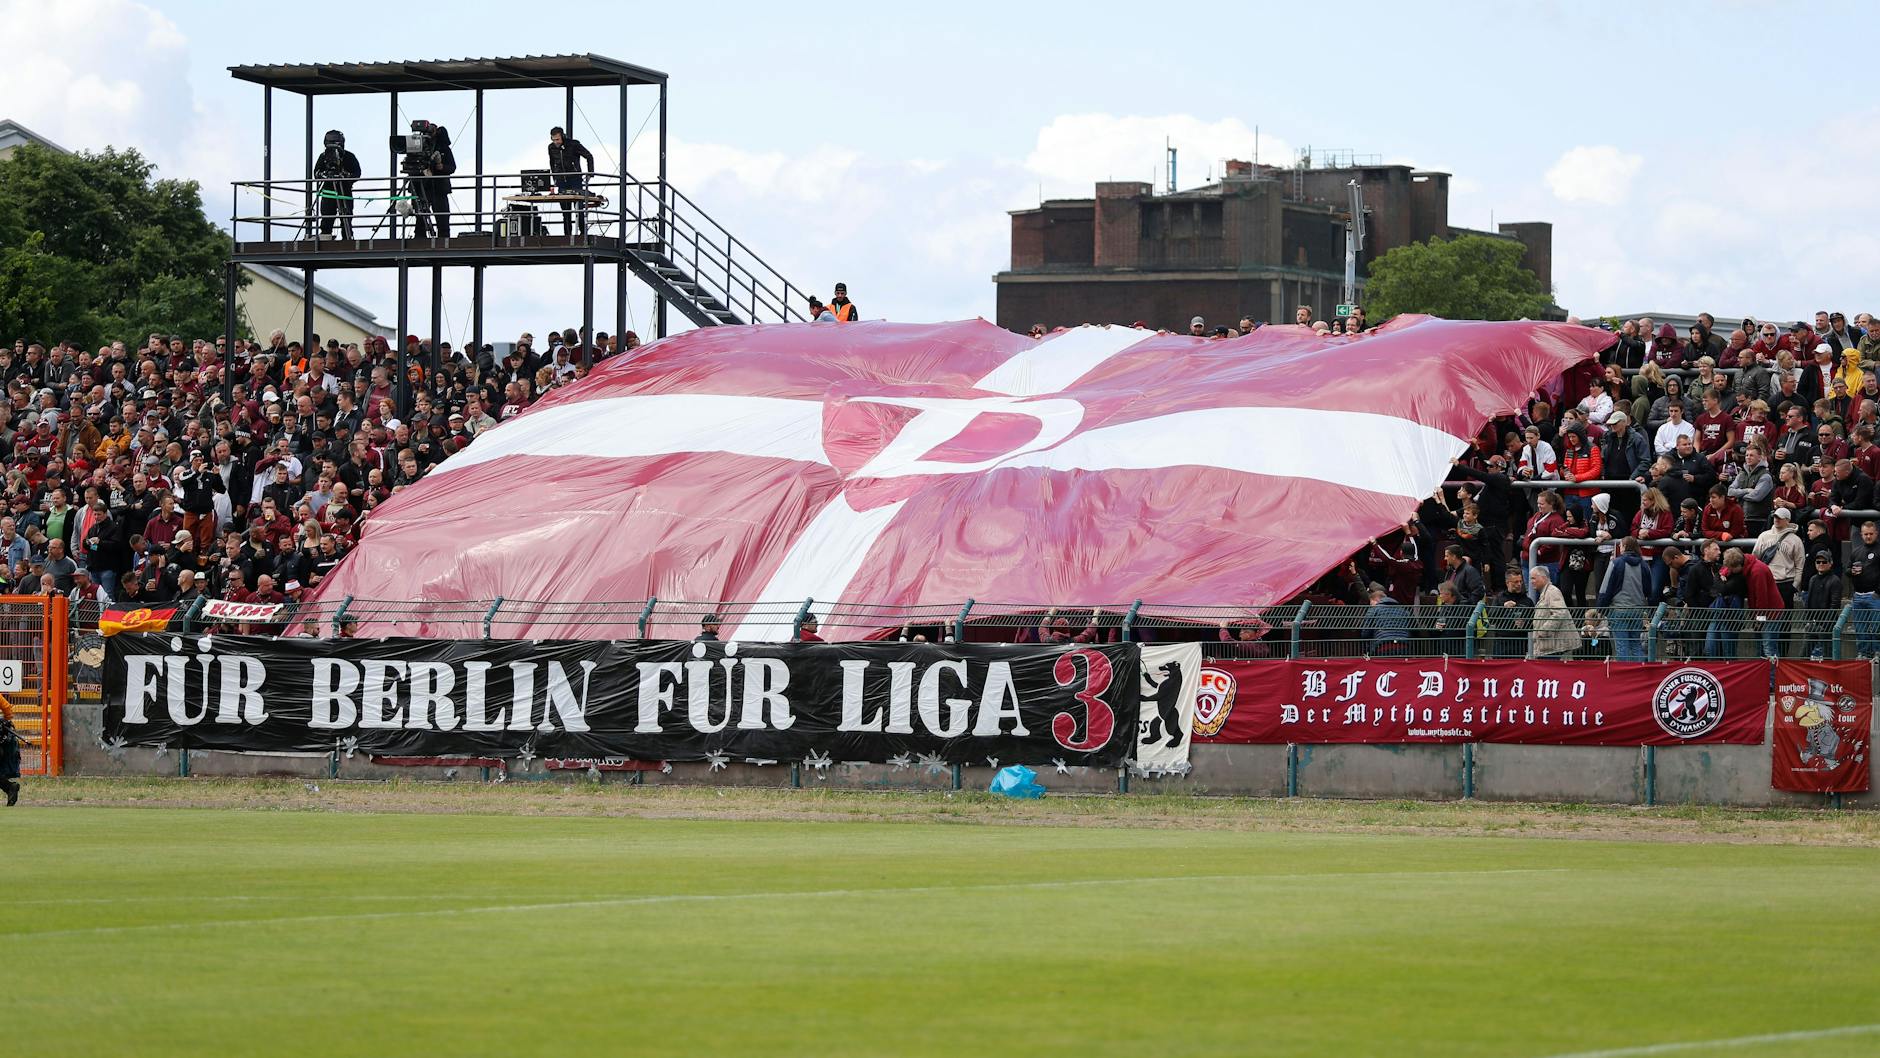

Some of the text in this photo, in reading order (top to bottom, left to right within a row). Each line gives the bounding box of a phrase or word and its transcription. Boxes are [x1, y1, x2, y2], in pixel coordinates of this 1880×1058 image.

[1745, 425, 1765, 434] BFC
[2, 666, 13, 686] 9
[1201, 674, 1227, 692] FC
[122, 636, 1116, 752] FÜR BERLIN FÜR LIGA 3
[1301, 669, 1587, 703] BFC Dynamo
[1659, 674, 1718, 709] BERLINER FUSSBALL CLUB
[1779, 683, 1806, 693] mythos
[1280, 703, 1604, 727] Der Mythos stirbt nie
[1661, 711, 1670, 719] 19
[1784, 714, 1857, 723] on tour
[1669, 719, 1707, 733] DYNAMO
